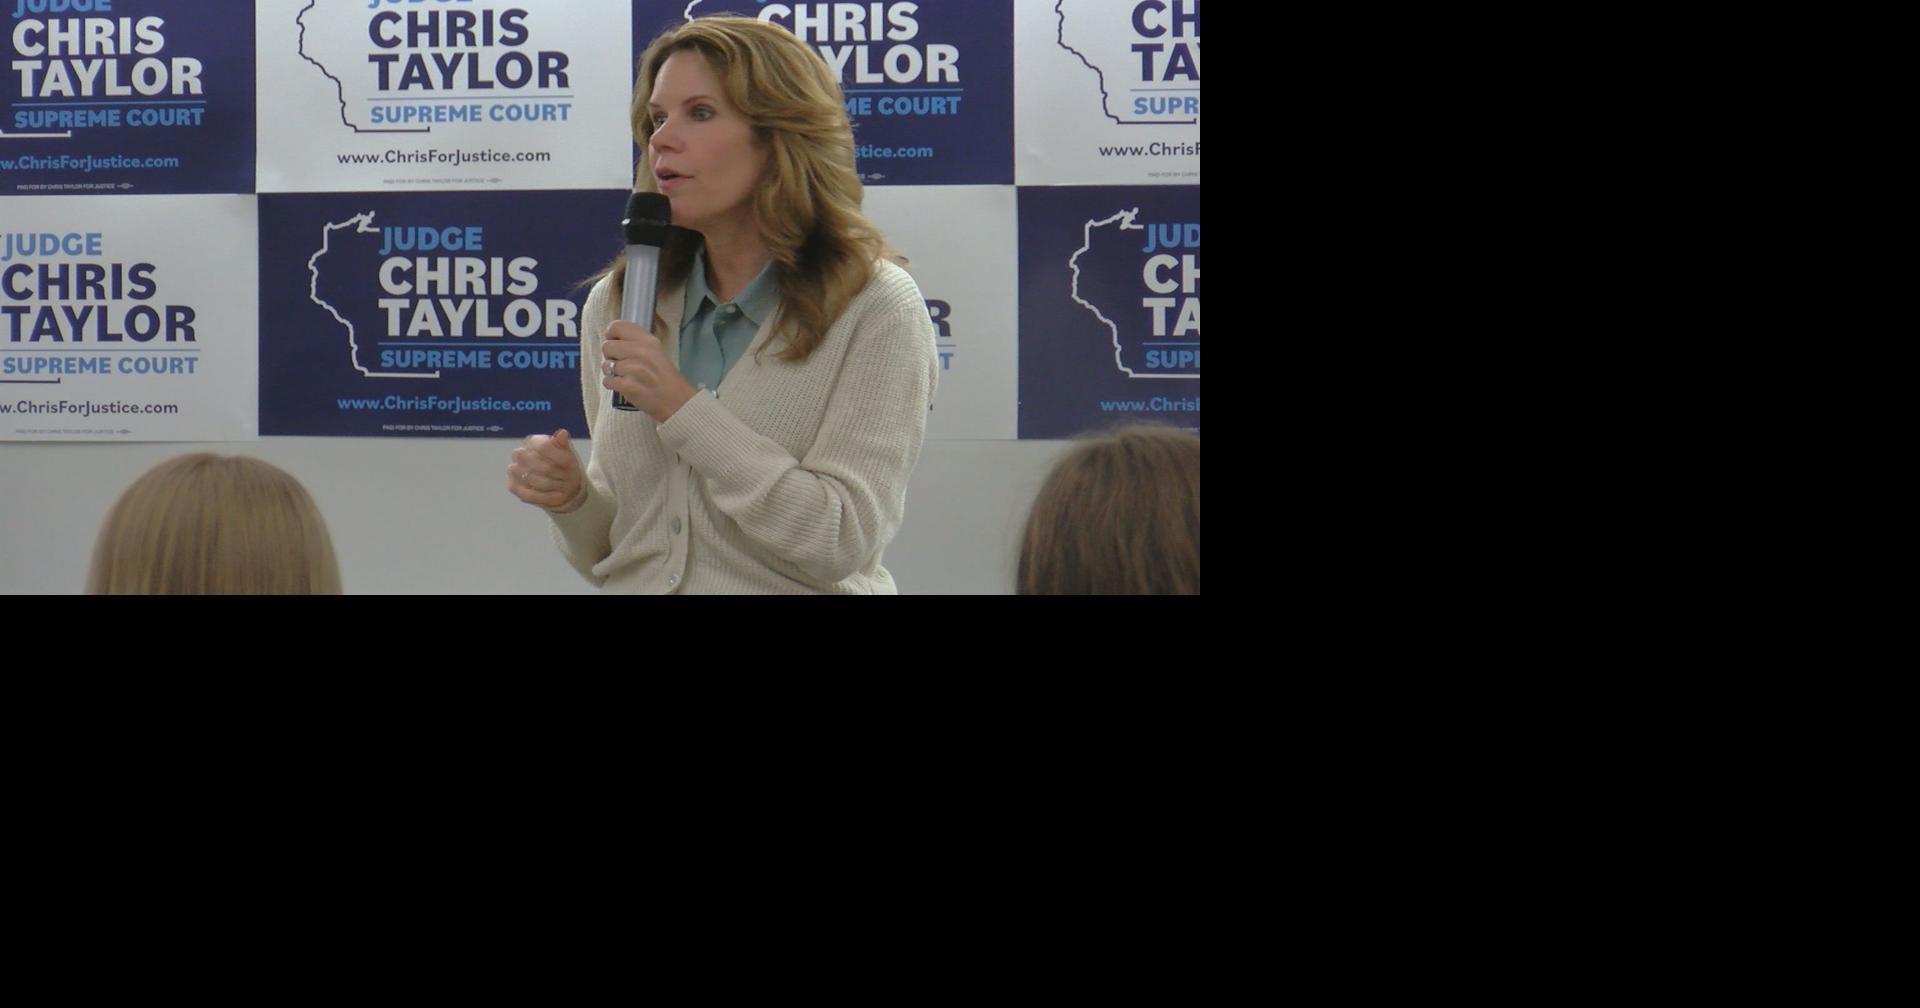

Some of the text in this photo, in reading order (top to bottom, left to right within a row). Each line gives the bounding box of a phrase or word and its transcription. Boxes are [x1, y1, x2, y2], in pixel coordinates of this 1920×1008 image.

[12, 16, 165, 56] CHRIS
[368, 8, 529, 48] CHRIS
[12, 57, 203, 97] TAYLOR
[368, 51, 570, 91] TAYLOR
[1131, 42, 1200, 82] TA
[15, 108, 205, 128] SUPREME COURT
[370, 104, 572, 123] SUPREME COURT
[877, 96, 962, 115] COURT
[337, 149, 551, 166] www.ChrisForJustice.com
[1, 233, 103, 261] JUDGE
[379, 227, 483, 255] JUDGE
[1, 263, 157, 300] CHRIS
[378, 256, 539, 296] CHRIS
[1, 305, 197, 342] TAYLOR
[378, 298, 578, 337] TAYLOR
[3, 357, 198, 374] SUPREME COURT
[380, 350, 579, 369] SUPREME COURT
[336, 396, 552, 414] www.ChrisForJustice.com
